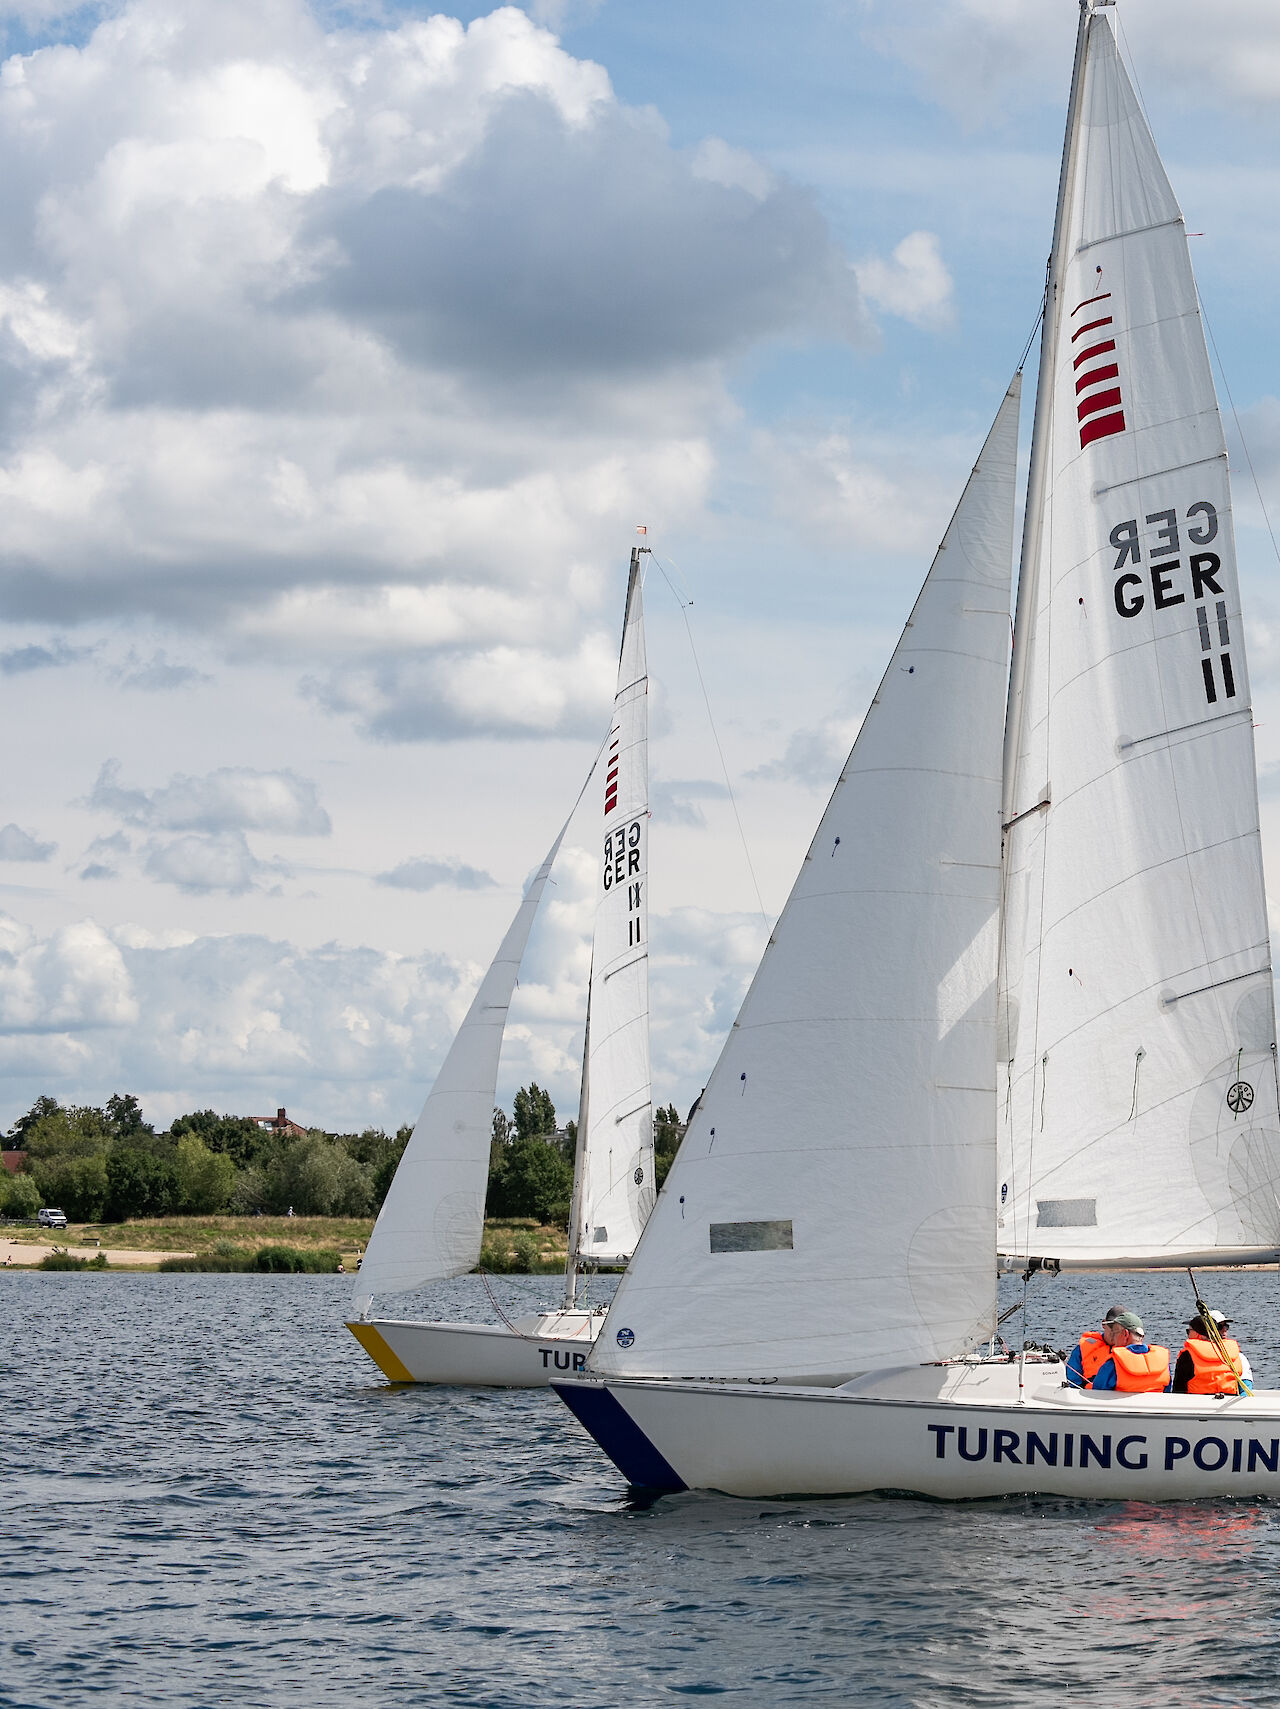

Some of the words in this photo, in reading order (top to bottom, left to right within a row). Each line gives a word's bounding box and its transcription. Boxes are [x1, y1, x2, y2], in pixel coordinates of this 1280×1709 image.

[1114, 552, 1225, 618] GER
[603, 848, 641, 890] GER
[927, 1423, 1148, 1470] TURNING
